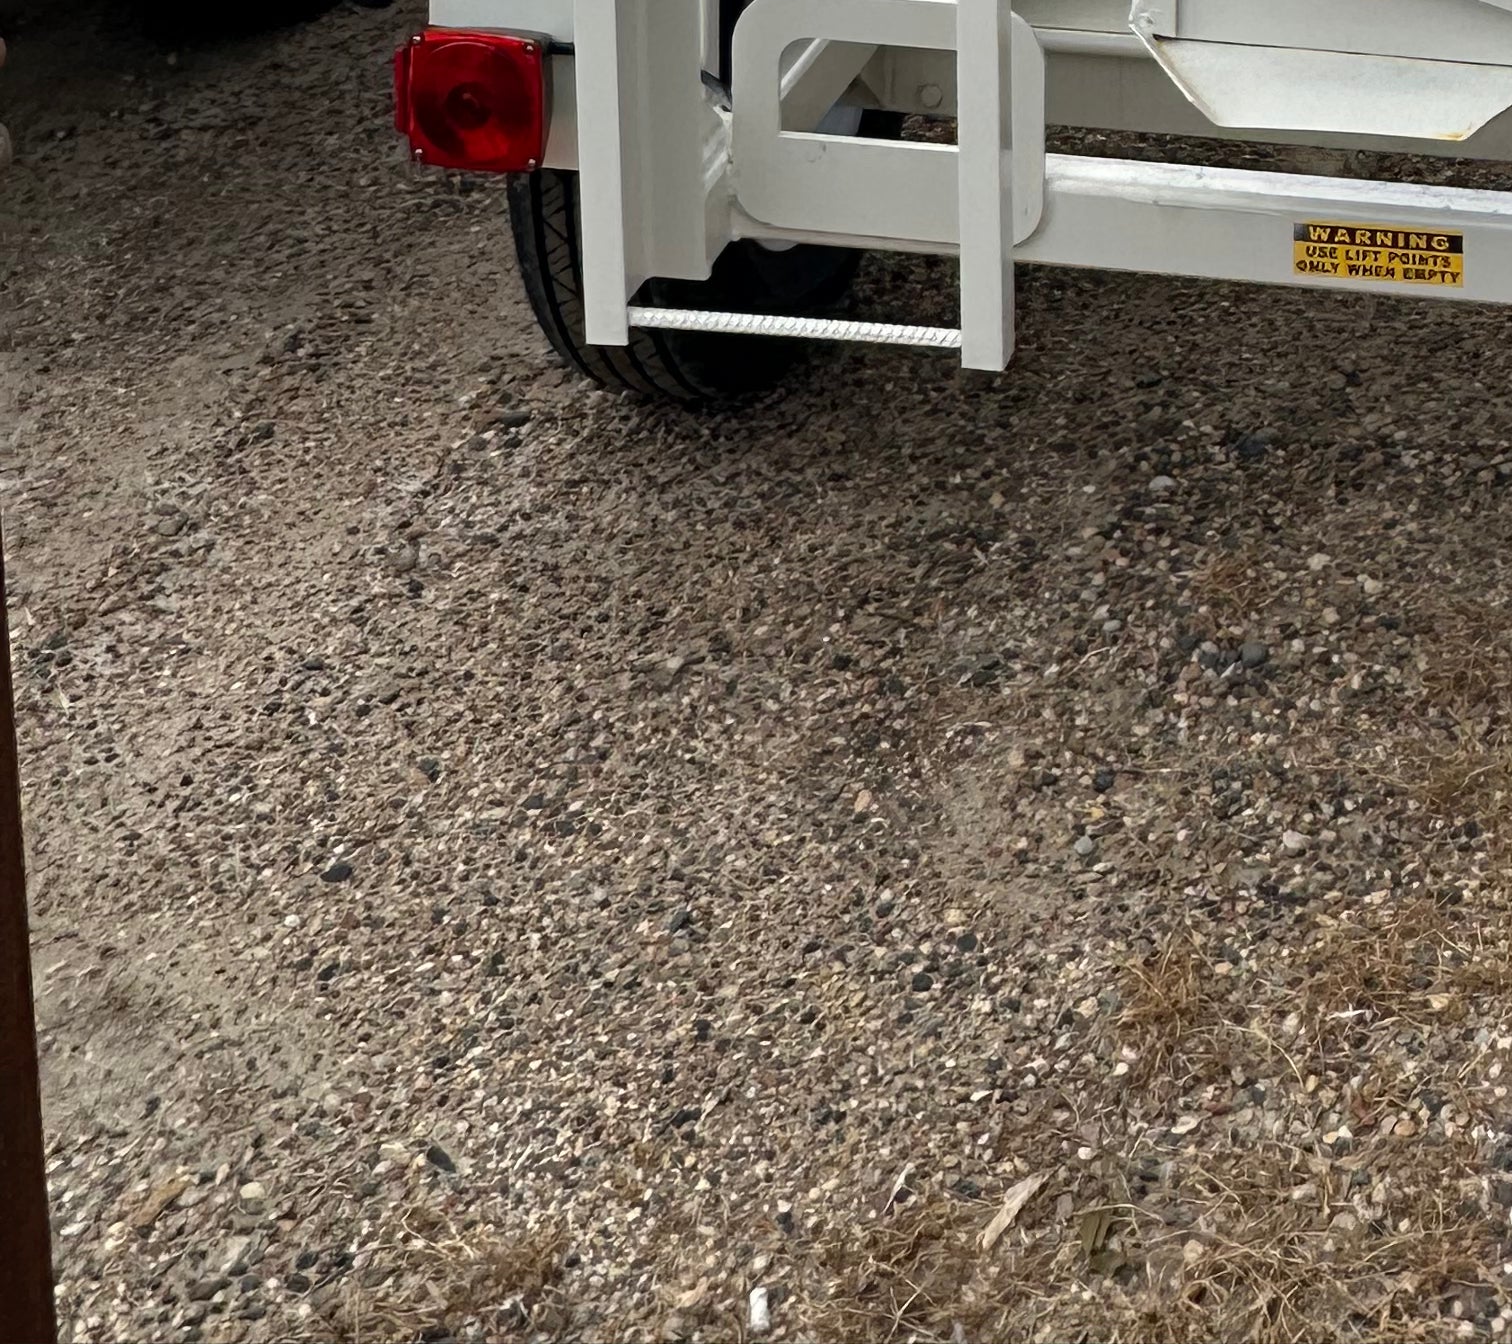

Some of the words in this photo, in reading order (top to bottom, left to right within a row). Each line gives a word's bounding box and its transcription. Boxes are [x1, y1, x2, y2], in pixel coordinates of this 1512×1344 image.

[1308, 225, 1450, 250] WARNING
[1305, 245, 1338, 260] USE
[1345, 249, 1381, 262] LIFT
[1388, 252, 1452, 269] POINTS
[1296, 259, 1340, 274] ONLY
[1348, 263, 1395, 279] WHEN
[1403, 267, 1461, 284] EMPTY
